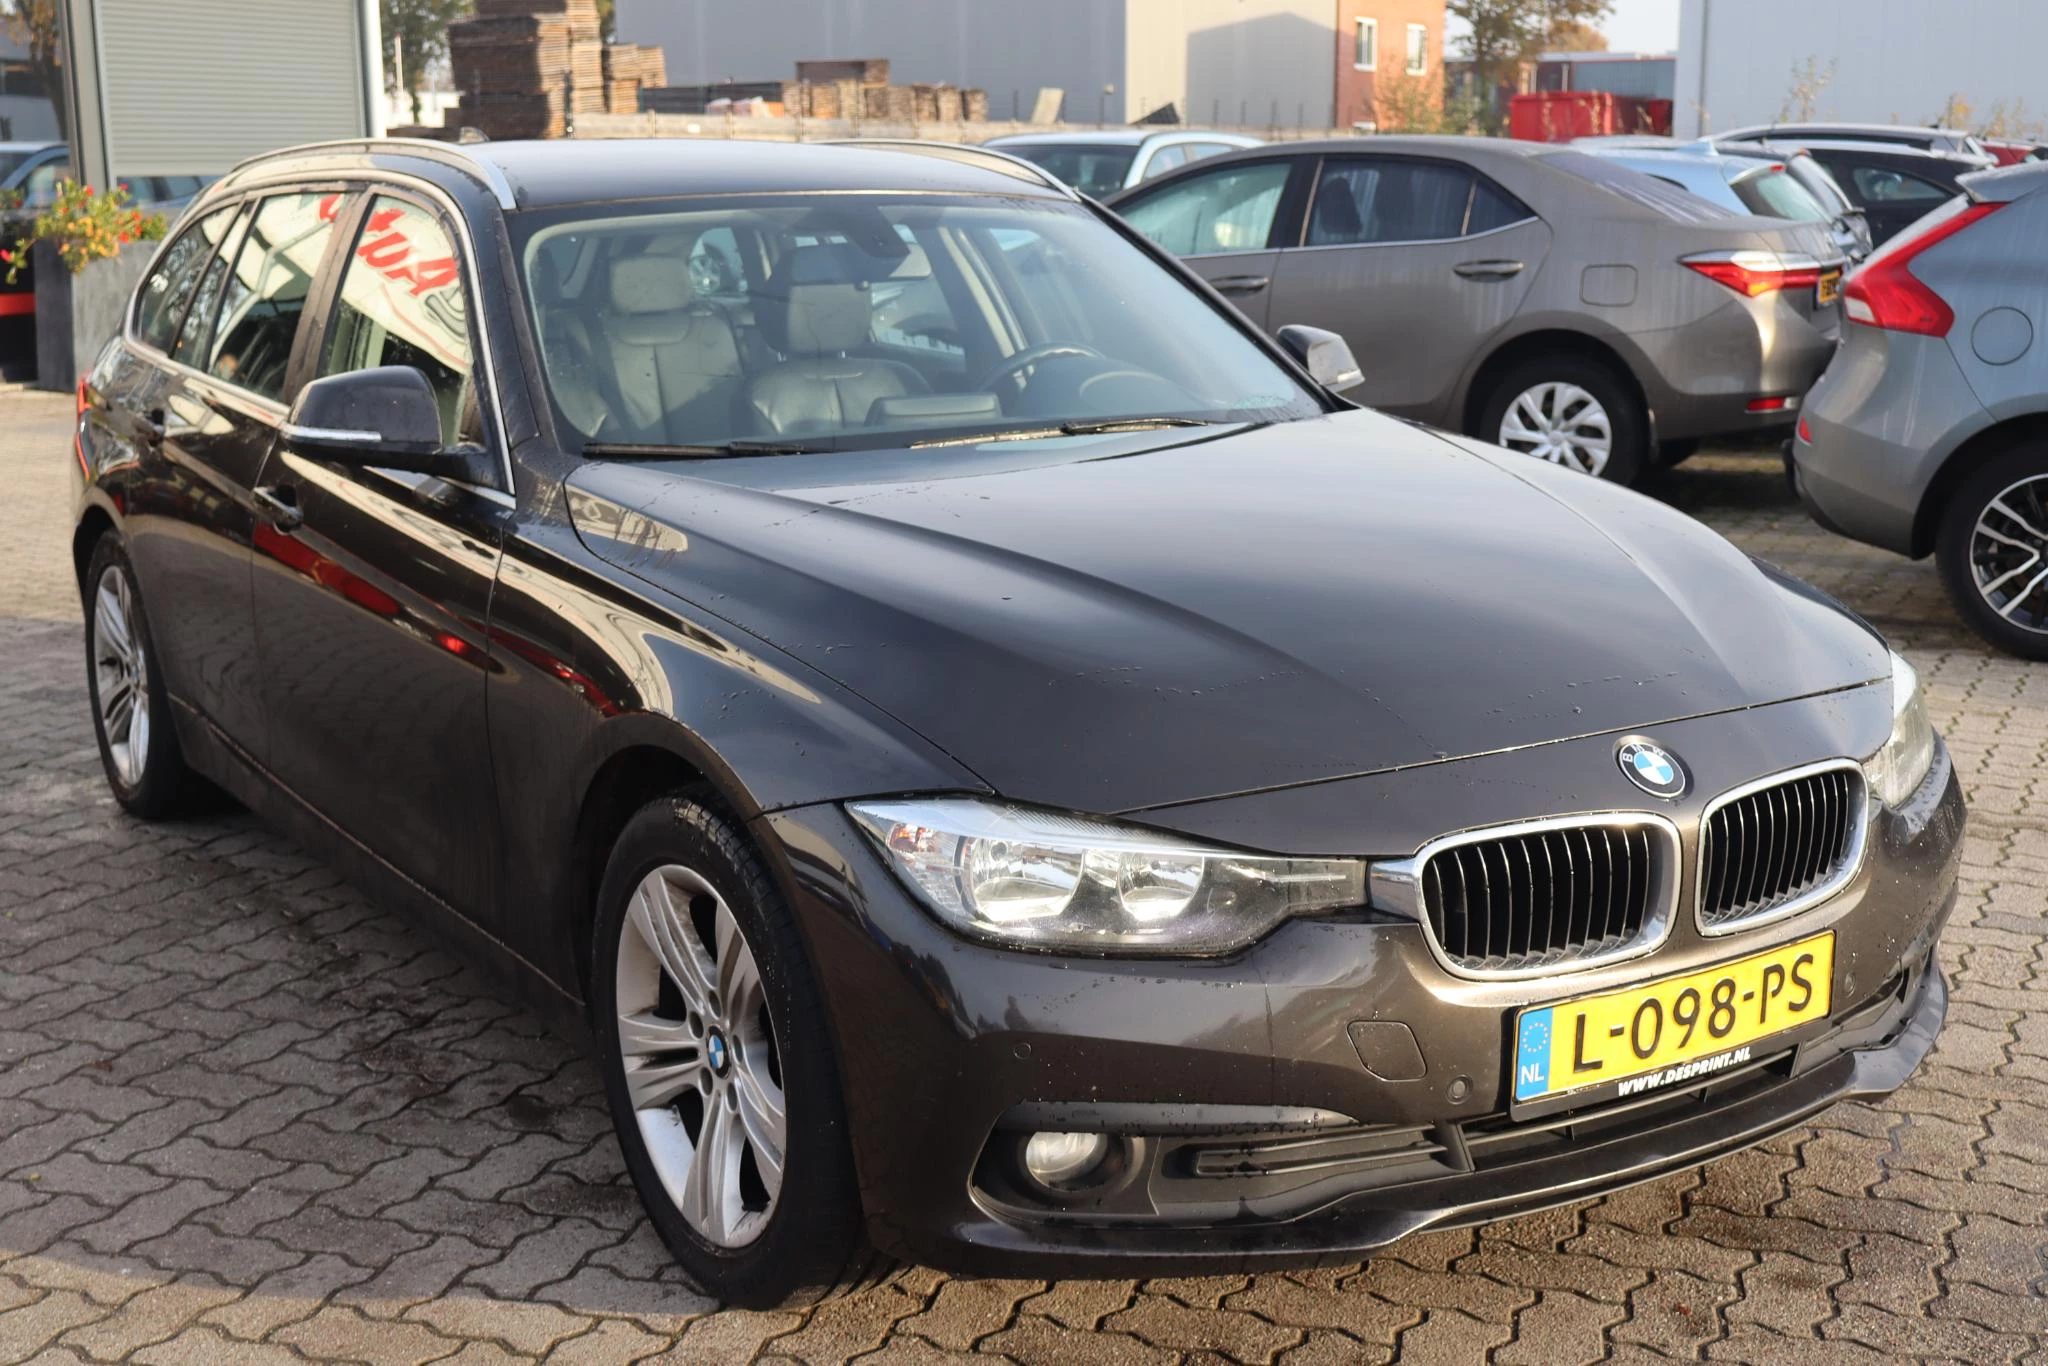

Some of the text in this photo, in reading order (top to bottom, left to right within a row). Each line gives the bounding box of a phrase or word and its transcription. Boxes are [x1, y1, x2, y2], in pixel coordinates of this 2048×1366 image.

[1622, 744, 1665, 763] BMW
[1573, 953, 1814, 1073] L-098-PS
[1521, 1063, 1544, 1085] NL
[1618, 1046, 1751, 1096] WWW.DESPRINT.NL
